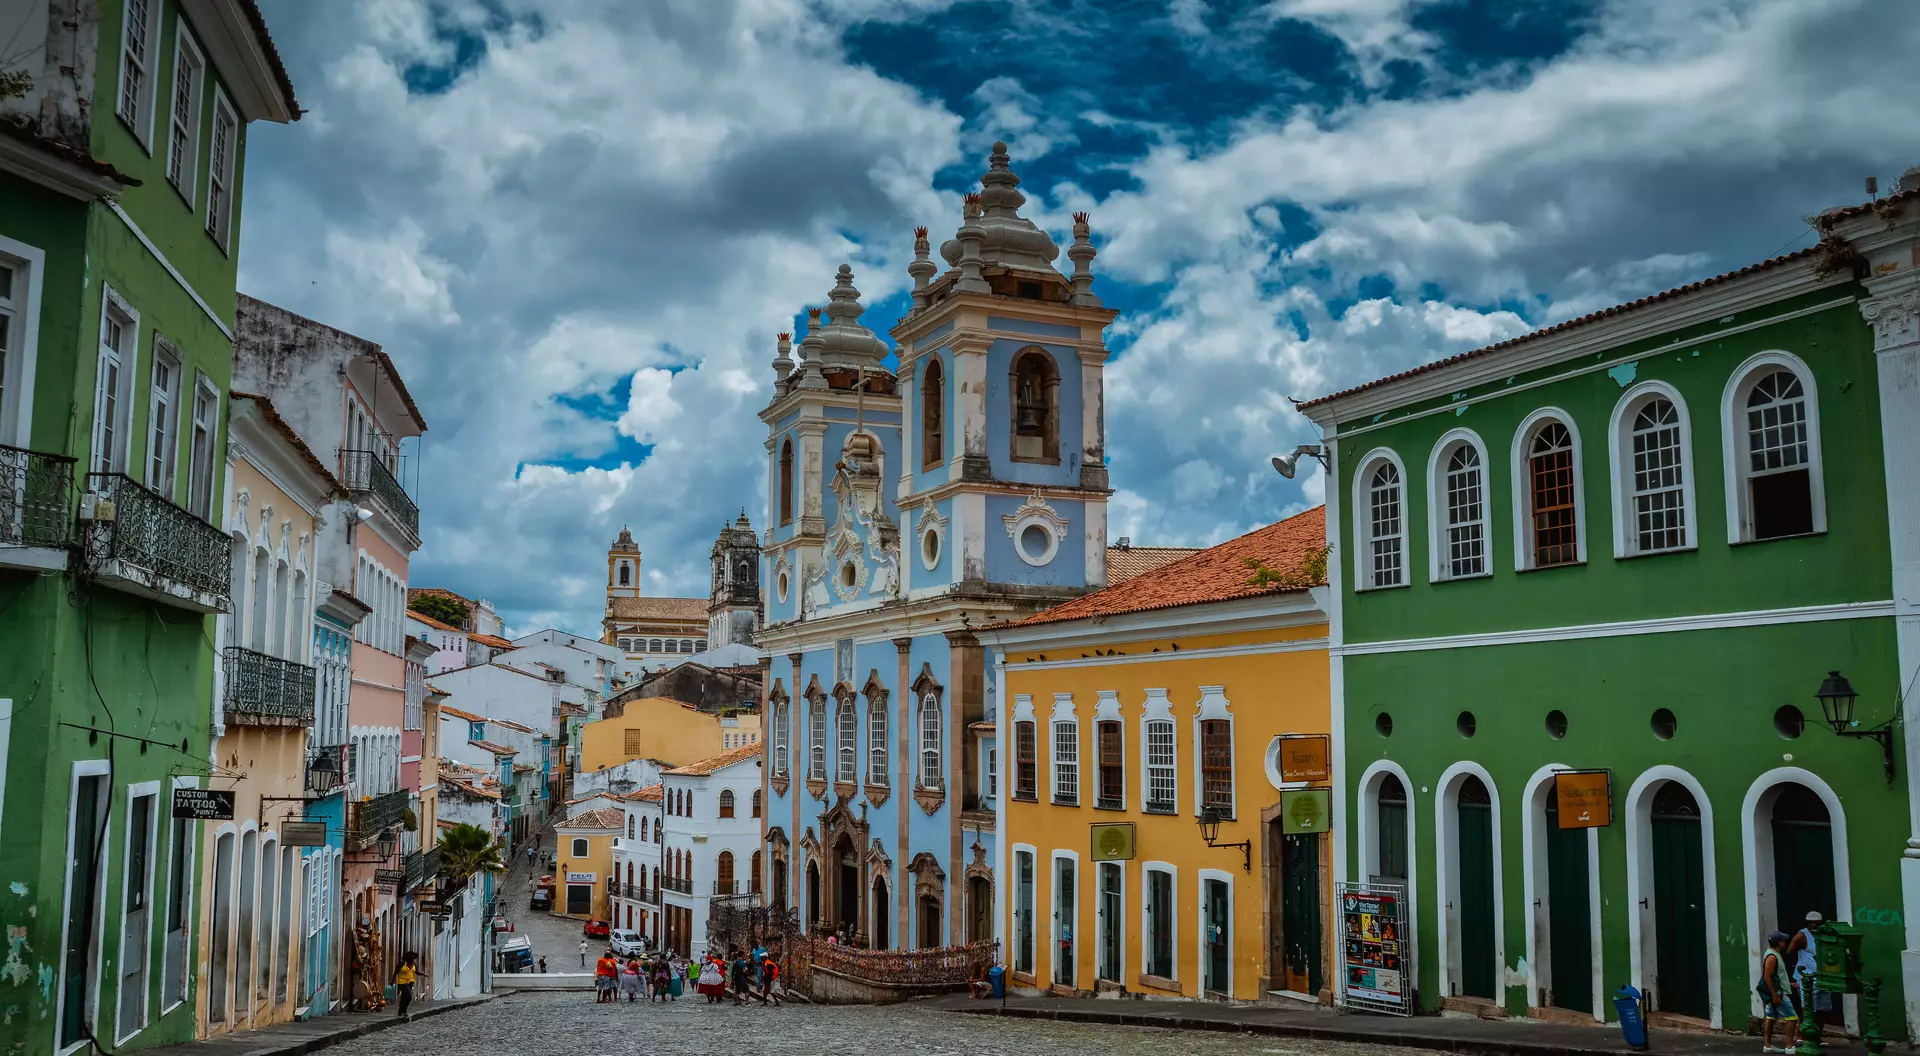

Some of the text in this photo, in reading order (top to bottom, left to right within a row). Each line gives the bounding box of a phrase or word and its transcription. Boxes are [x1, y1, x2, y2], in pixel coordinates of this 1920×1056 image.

[176, 790, 208, 799] CUSTOM
[176, 798, 216, 809] TATTOO
[1856, 905, 1904, 928] CECA
